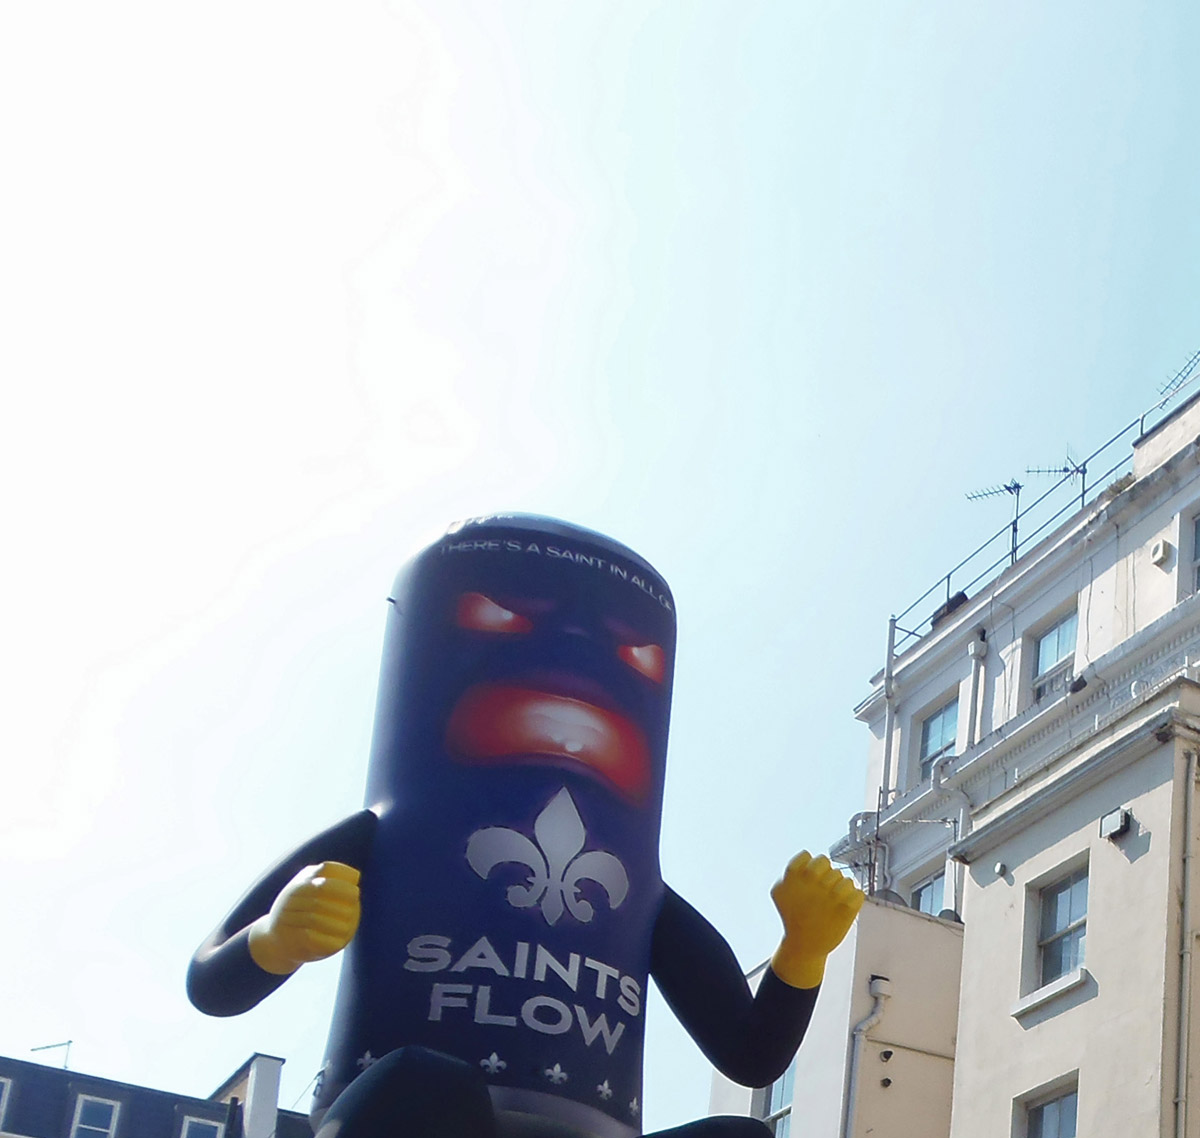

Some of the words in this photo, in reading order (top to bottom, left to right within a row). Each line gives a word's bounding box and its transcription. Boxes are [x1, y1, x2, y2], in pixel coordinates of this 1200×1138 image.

[526, 542, 541, 555] A
[546, 546, 605, 569] SAINT
[609, 563, 628, 580] IN
[403, 933, 641, 1016] SAINTS
[427, 982, 625, 1055] FLOW
